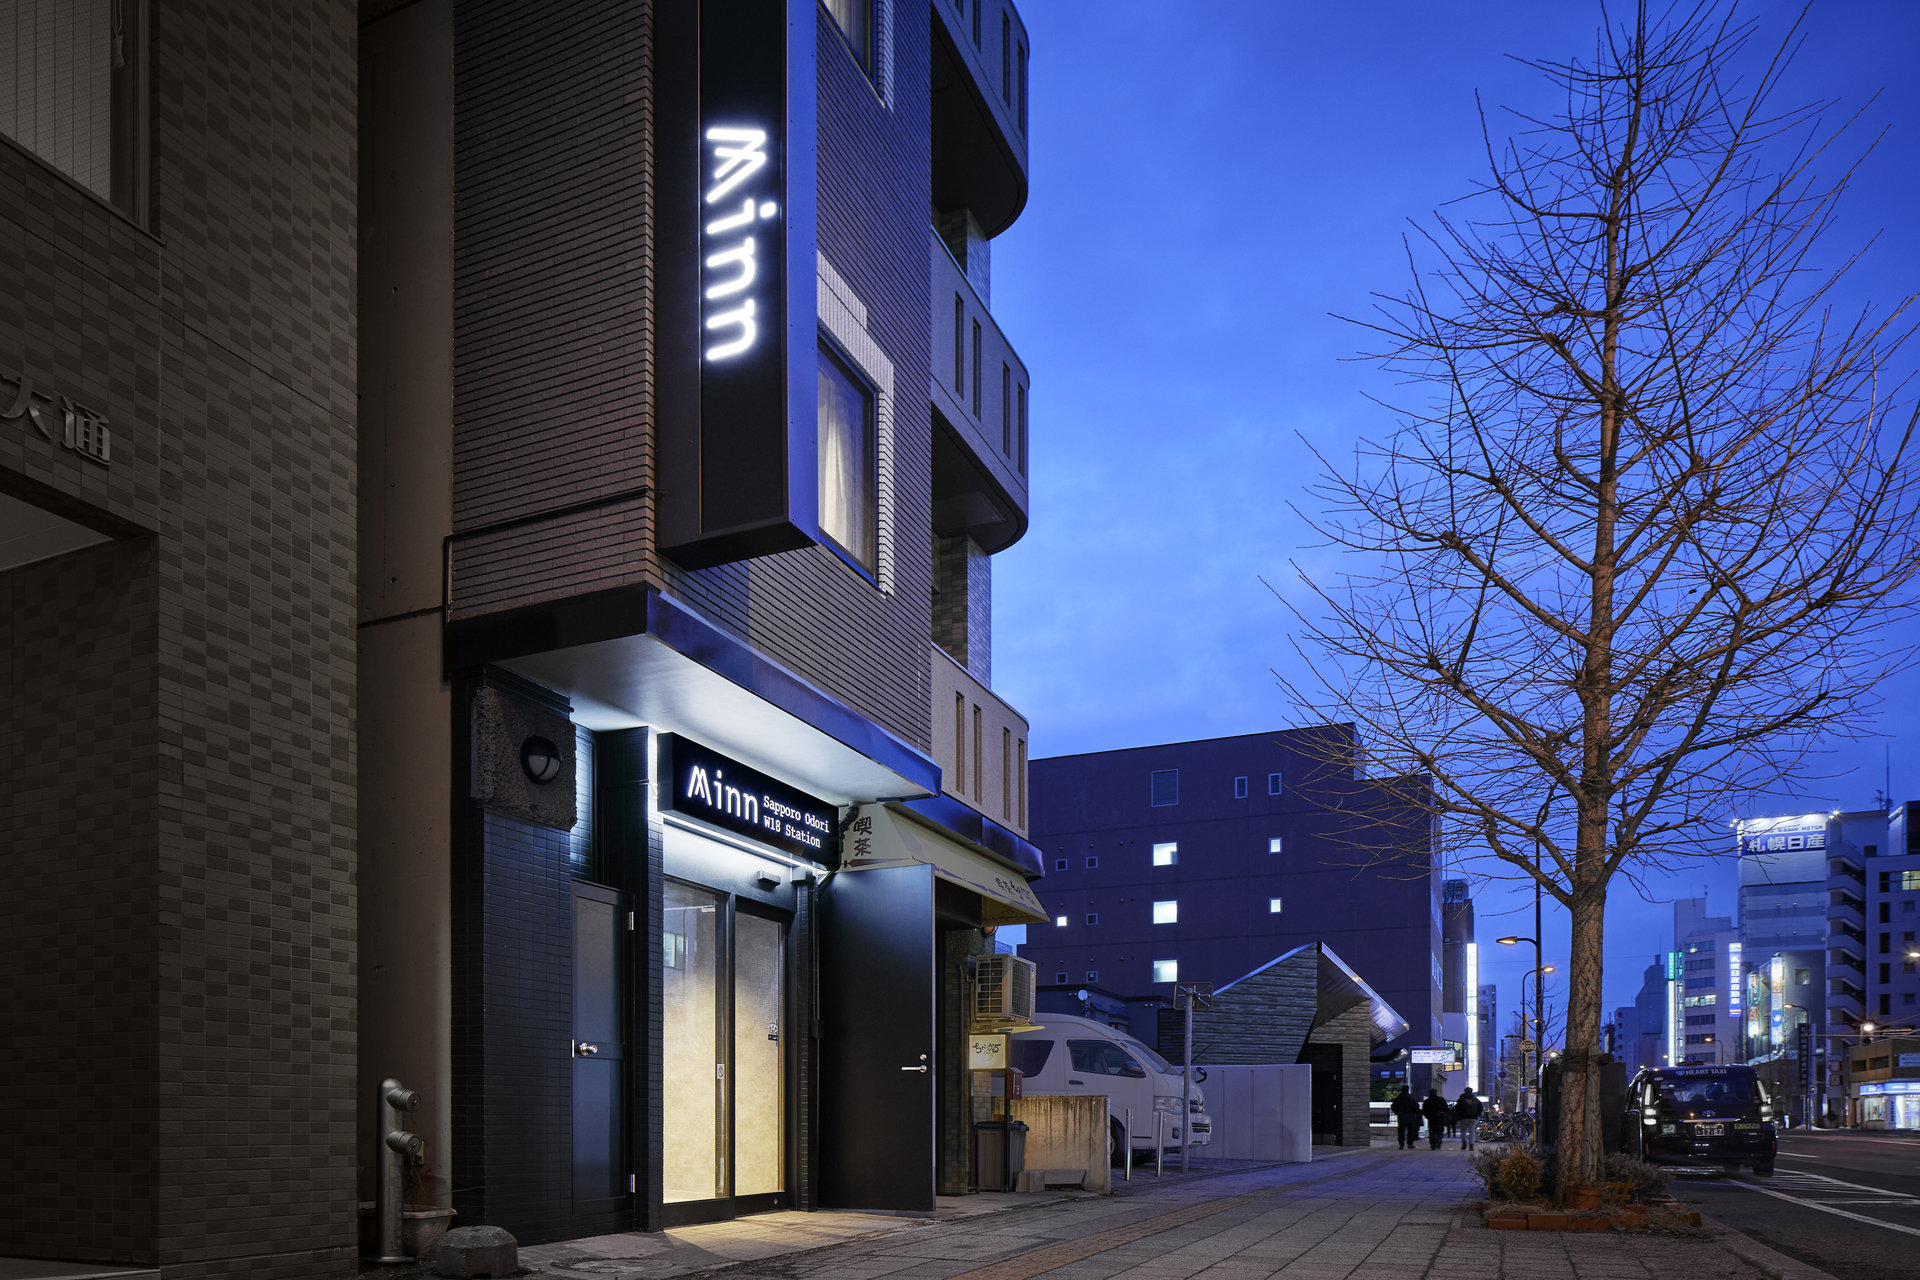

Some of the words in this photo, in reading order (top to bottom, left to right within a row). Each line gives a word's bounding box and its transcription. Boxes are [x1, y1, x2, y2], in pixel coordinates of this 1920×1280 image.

[706, 128, 777, 361] Minn
[0, 373, 111, 466] 大通
[687, 765, 759, 824] Minn
[763, 795, 802, 821] Sapporo
[804, 812, 830, 834] Odori
[763, 815, 781, 832] W18
[785, 824, 821, 849] Station
[852, 816, 873, 857] 喫茶
[1748, 834, 1825, 851] 札幌日産
